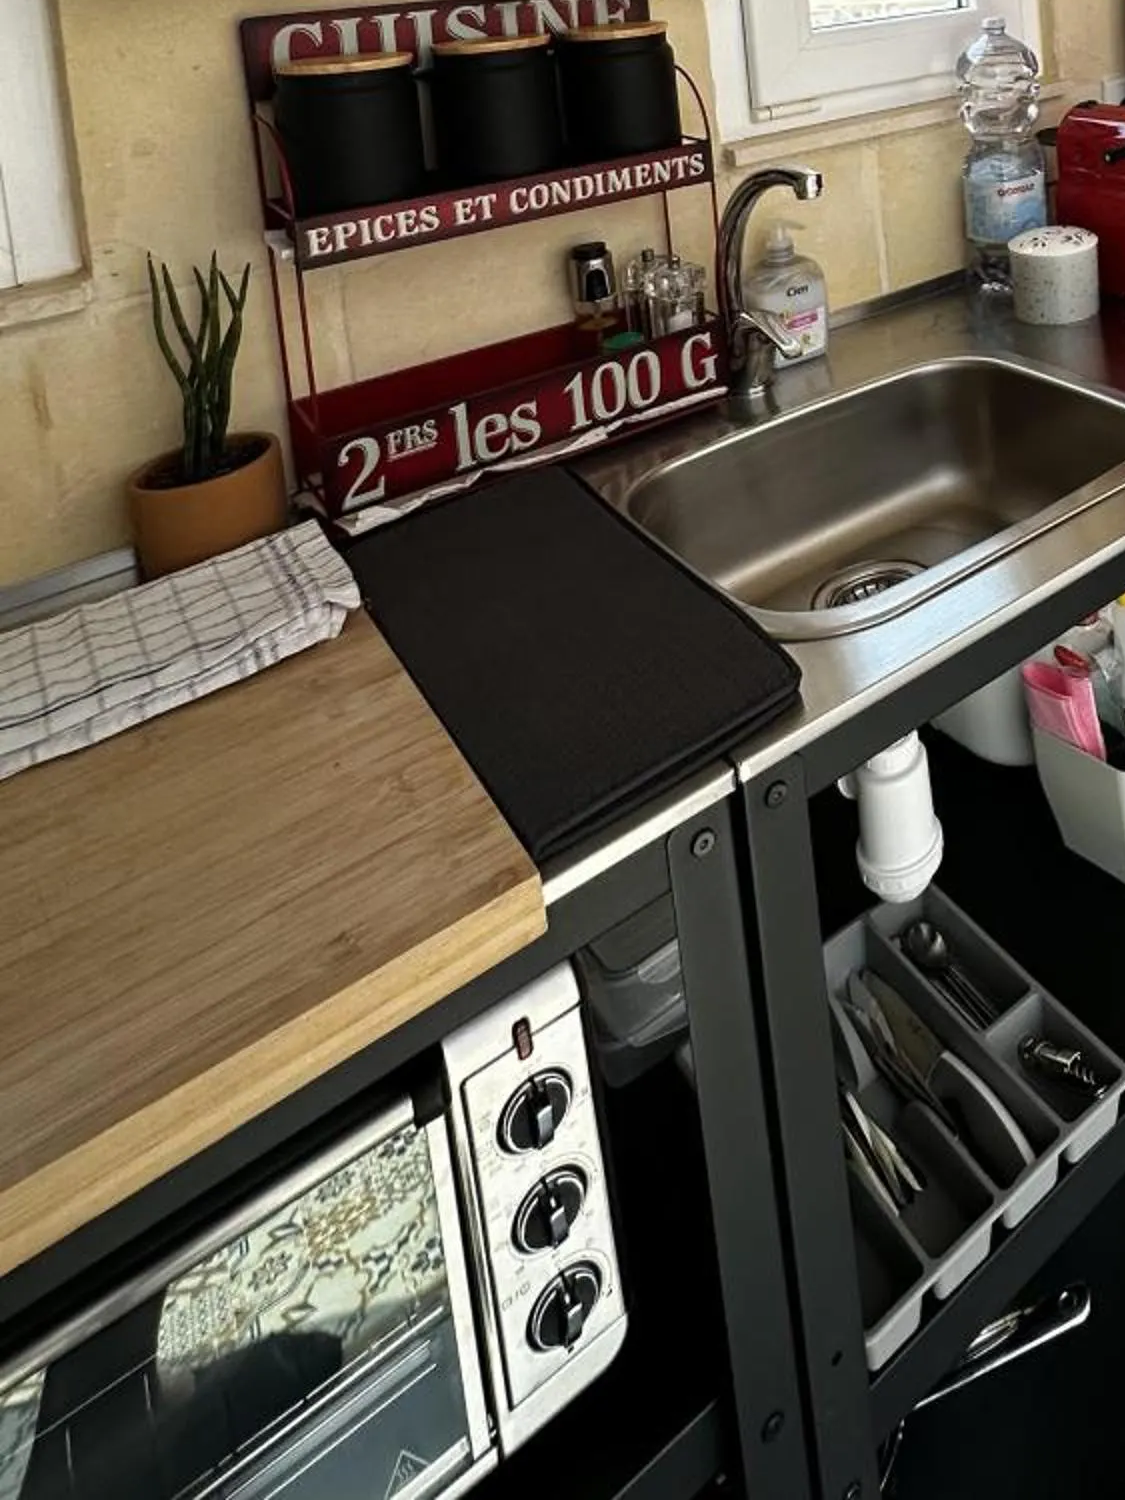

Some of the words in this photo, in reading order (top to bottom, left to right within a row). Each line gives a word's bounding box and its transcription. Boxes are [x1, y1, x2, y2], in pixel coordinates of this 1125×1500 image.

[305, 205, 441, 258] EPICES
[453, 193, 498, 227] ET
[509, 153, 706, 215] CONDIMENTS
[449, 400, 542, 473] les
[563, 350, 661, 432] 100
[681, 331, 719, 388] G
